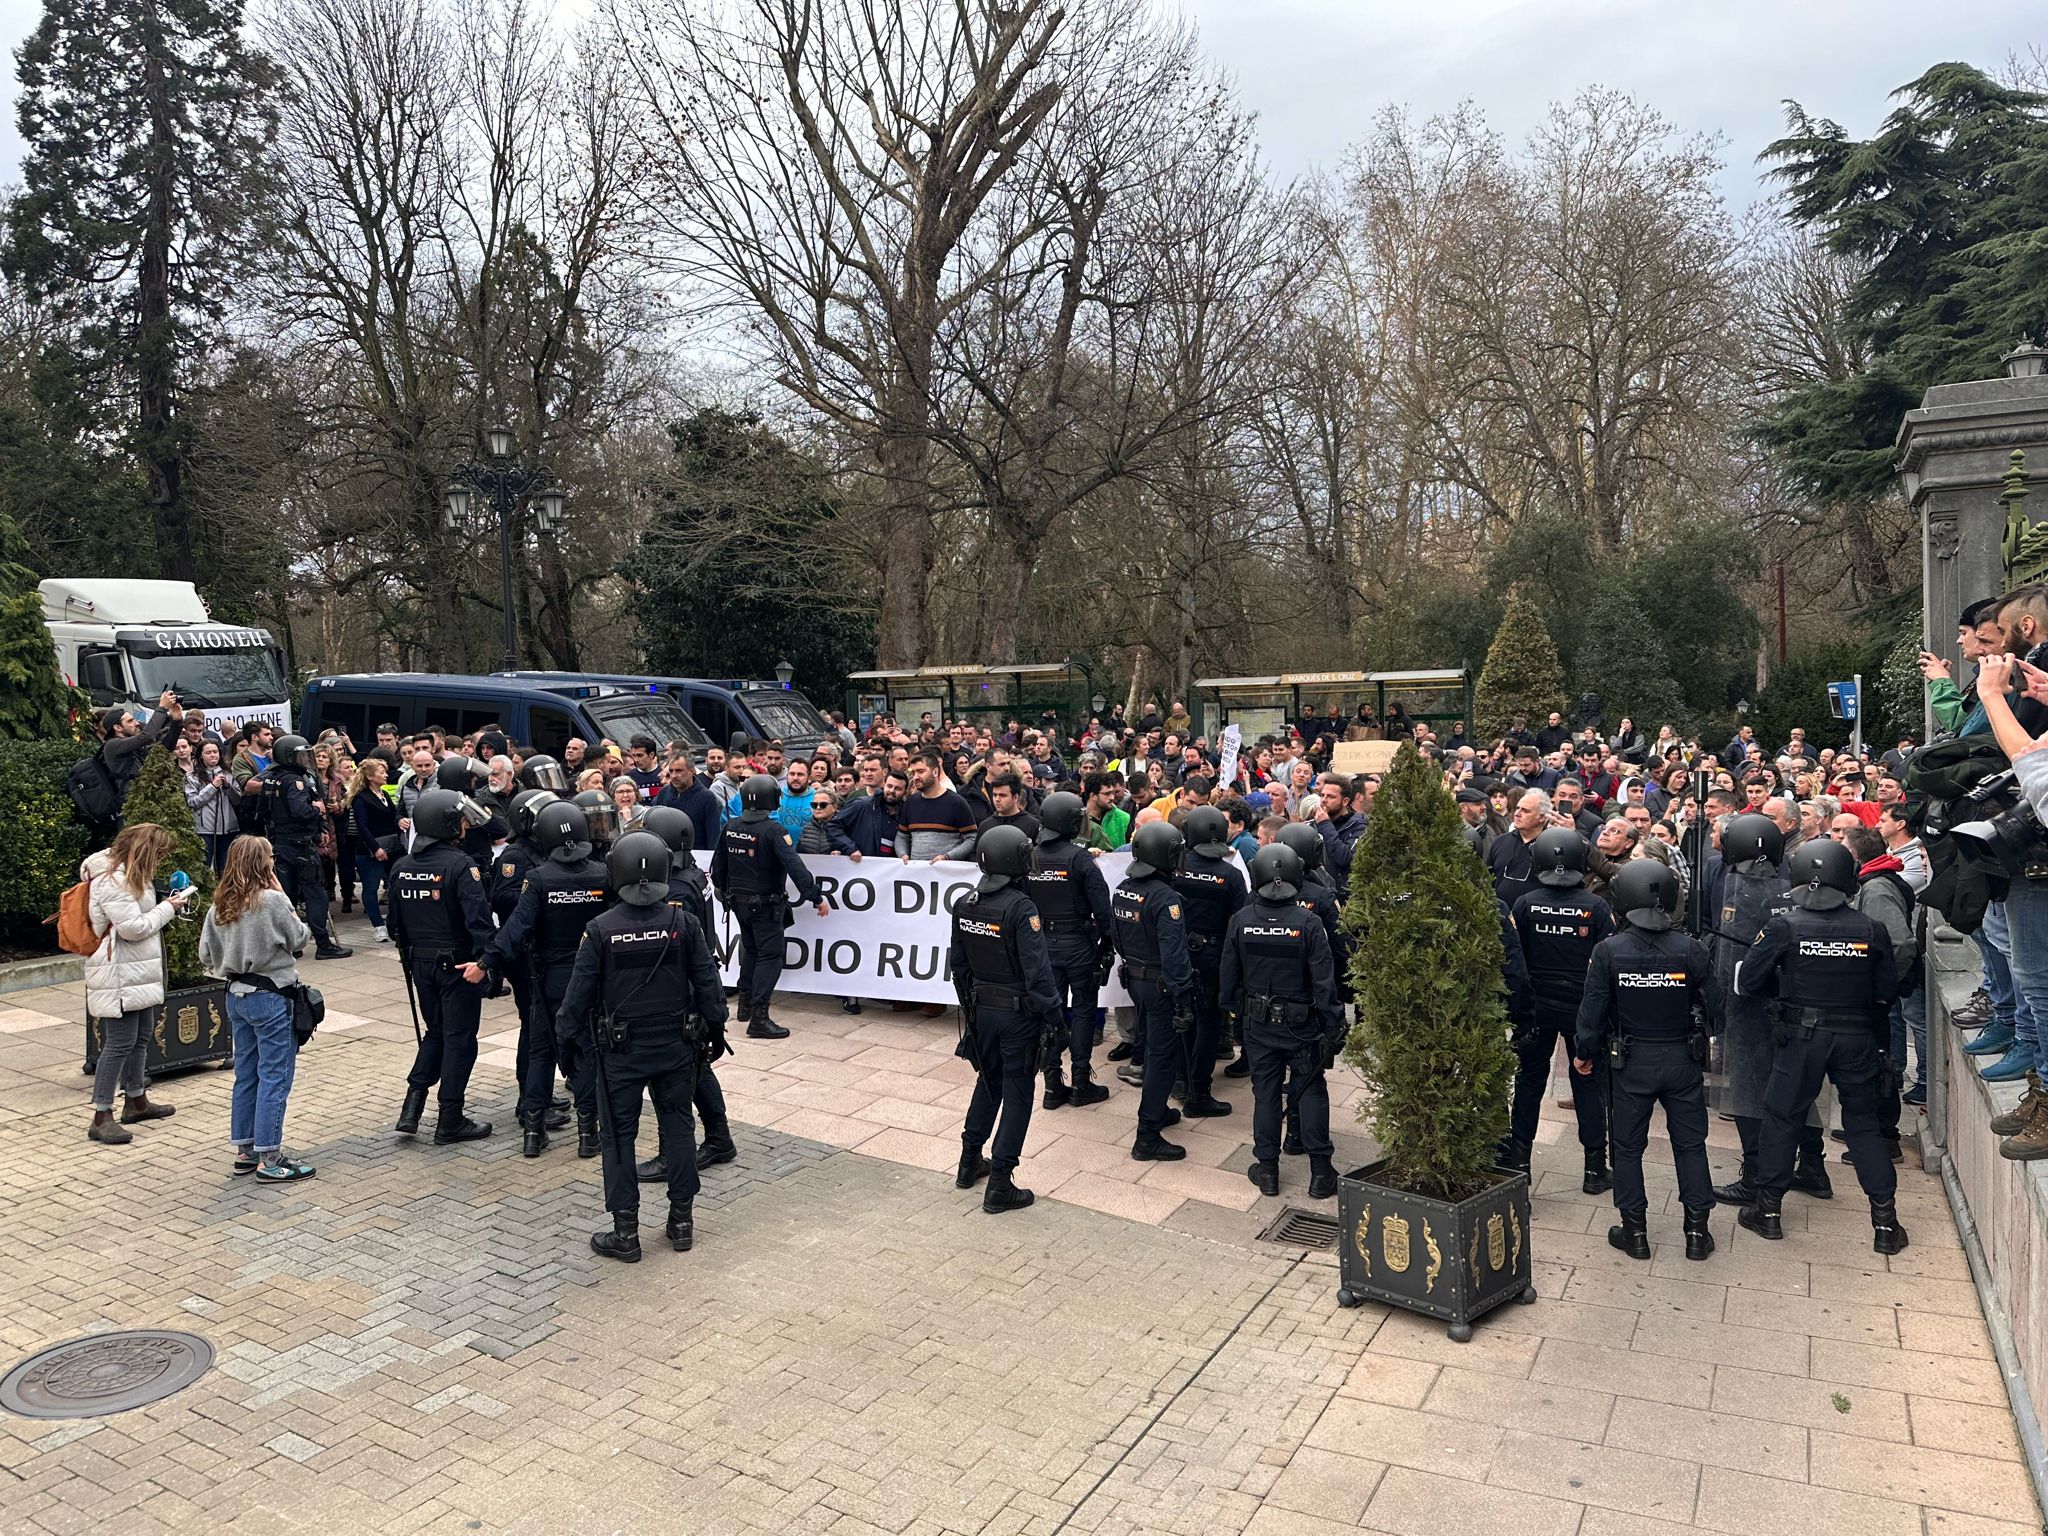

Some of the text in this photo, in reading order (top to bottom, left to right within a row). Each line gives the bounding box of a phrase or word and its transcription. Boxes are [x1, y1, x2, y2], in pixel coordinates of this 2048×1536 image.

[155, 631, 266, 650] GAMONEU
[1338, 673, 1355, 681] CRUZ
[1847, 707, 1856, 718] 30
[726, 831, 752, 840] POLICIA
[399, 872, 435, 881] POLICIA
[1185, 871, 1217, 881] OLICIA
[401, 889, 431, 899] UIP
[548, 890, 592, 898] POLICIA
[548, 896, 603, 904] NACIONAL
[1531, 905, 1583, 916] POLICIA
[960, 918, 991, 930] POLICIA
[960, 925, 1000, 938] NACIONAL
[1244, 927, 1292, 935] POLICIA
[1535, 923, 1577, 936] U.I.P.
[611, 930, 668, 943] POLICIA
[1800, 941, 1854, 950] POLICIA
[1800, 949, 1867, 957] NACIONAL
[1619, 973, 1671, 981] POLICIA
